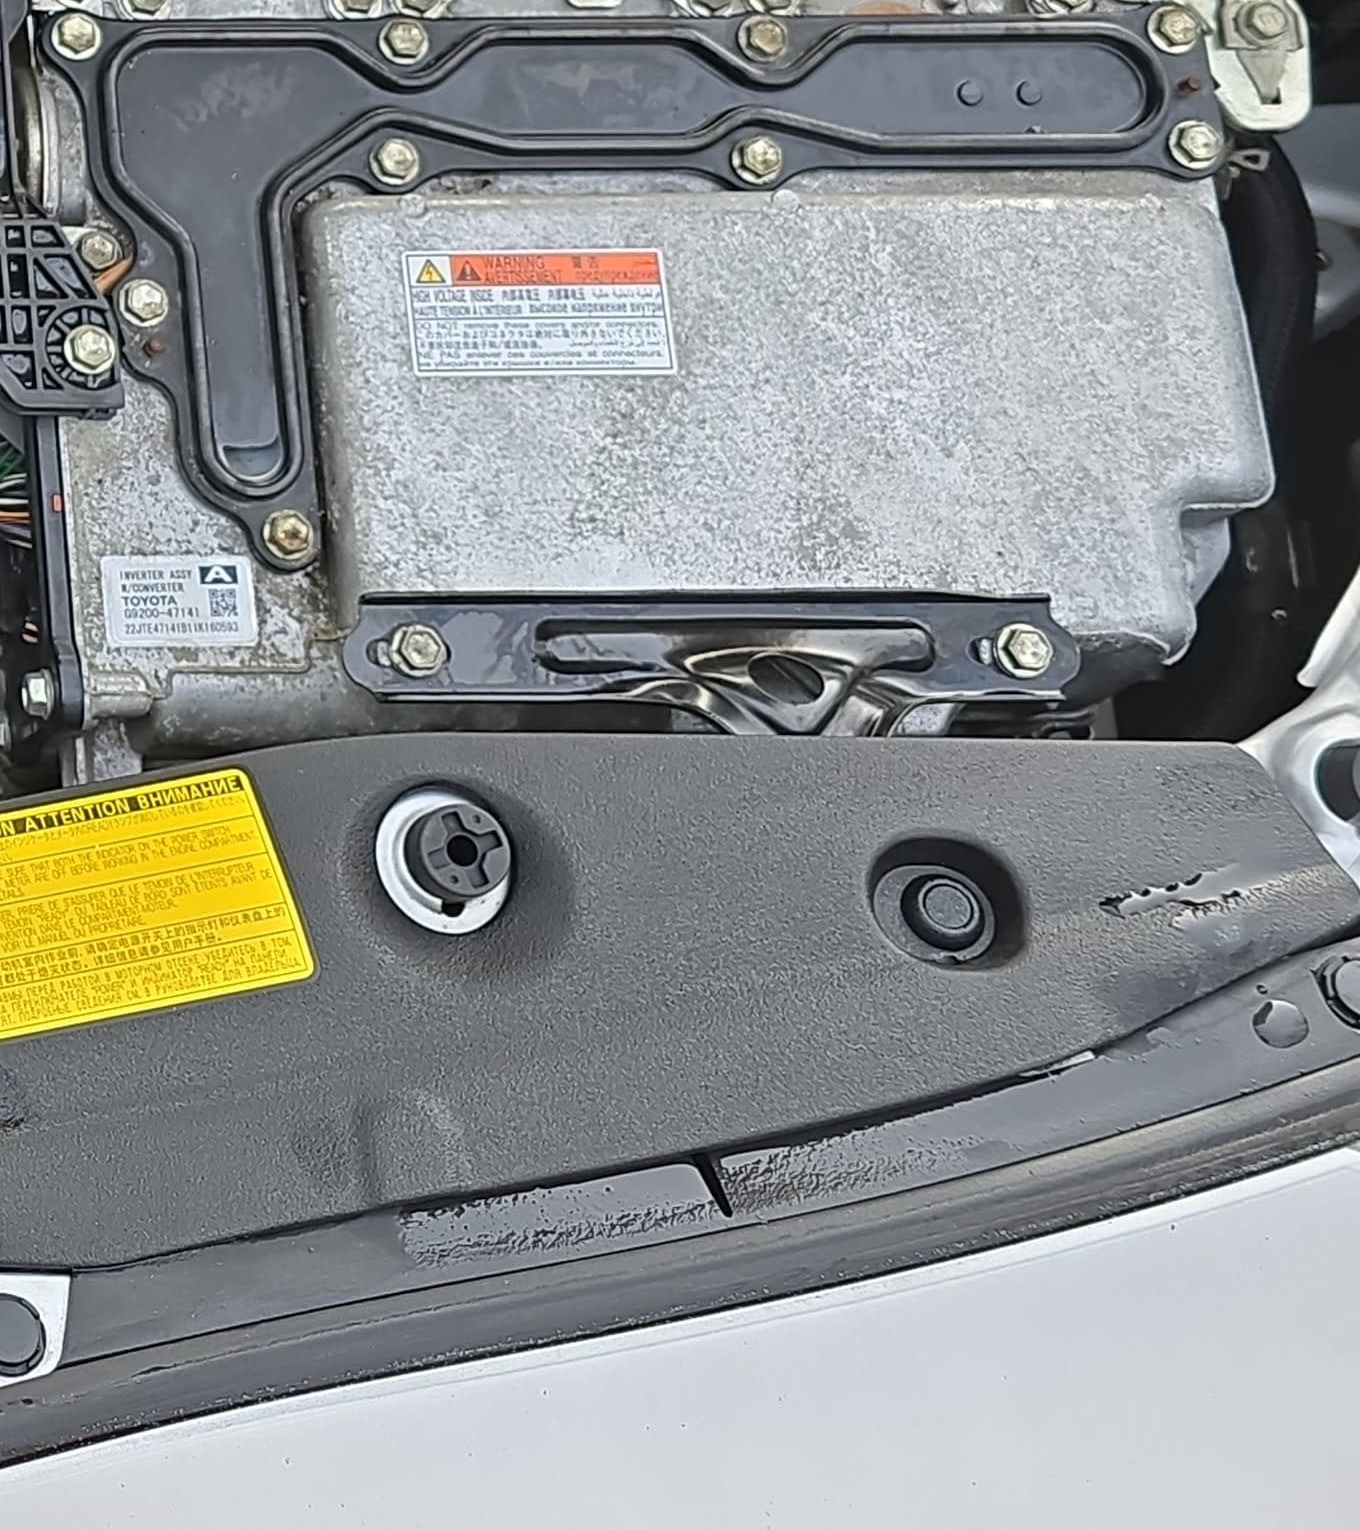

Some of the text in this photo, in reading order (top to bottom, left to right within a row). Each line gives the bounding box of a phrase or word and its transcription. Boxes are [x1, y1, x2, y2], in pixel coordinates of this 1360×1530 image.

[482, 255, 545, 269] WARNING
[482, 269, 563, 283] AVERTISSEMENT
[119, 569, 193, 581] INVERTER ASSY
[121, 583, 184, 593] W/CONVERTER
[121, 595, 178, 607] TOYOTA
[124, 608, 199, 619] G9200-47141
[21, 797, 131, 832] ATTENTION
[134, 775, 241, 810] ВНИМАНИЕ
